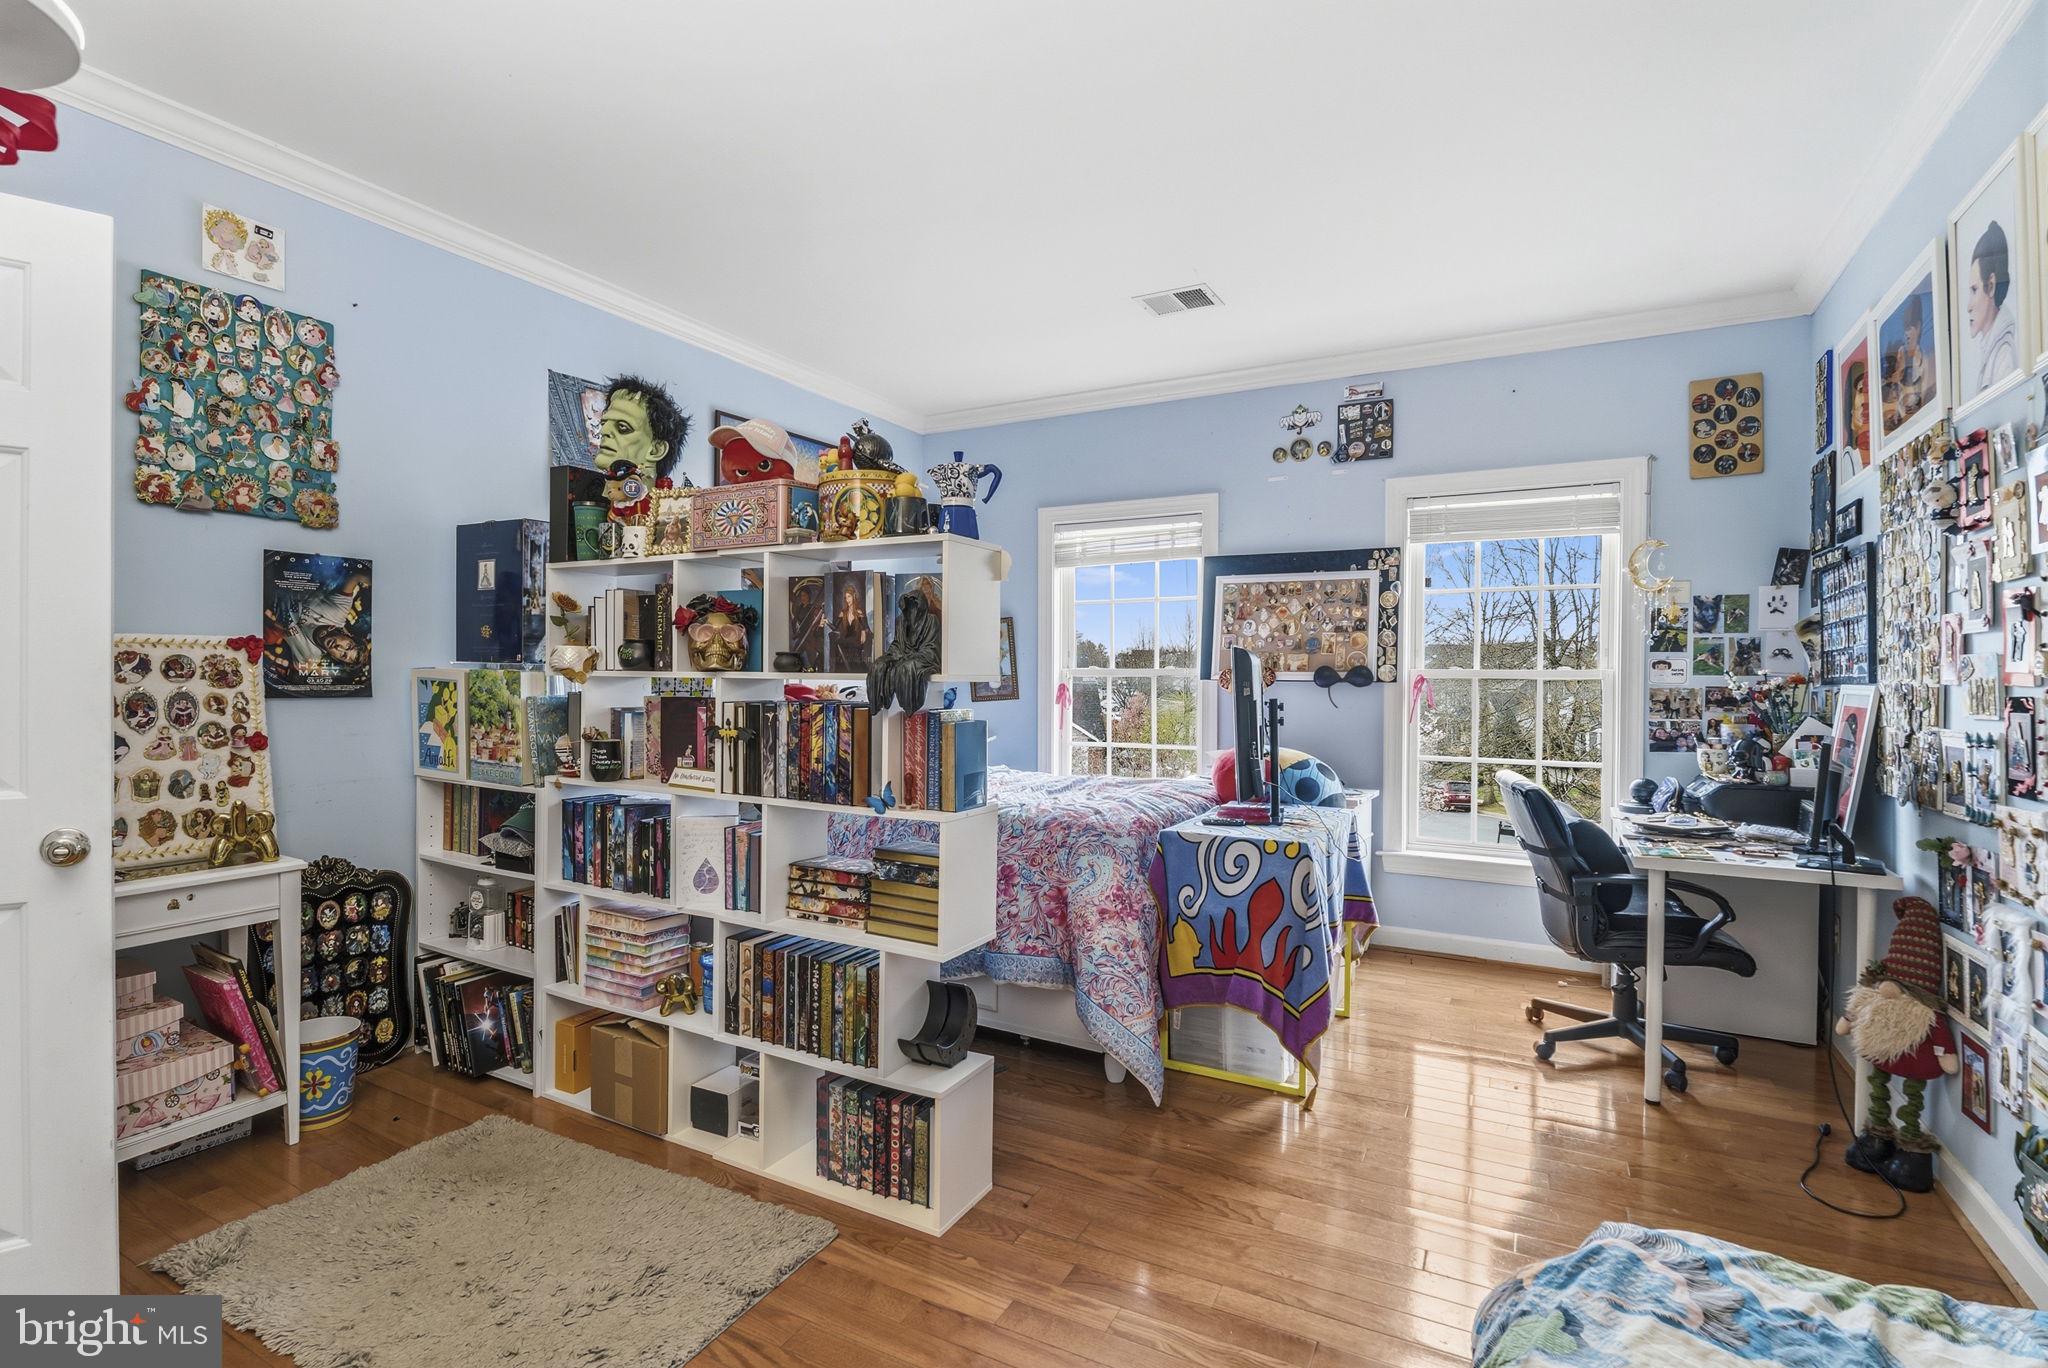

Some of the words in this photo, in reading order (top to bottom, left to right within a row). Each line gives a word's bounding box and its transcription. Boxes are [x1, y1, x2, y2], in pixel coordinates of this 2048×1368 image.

[275, 555, 363, 569] GOSLING
[298, 662, 340, 670] HAIL
[298, 669, 340, 677] MARY
[527, 711, 535, 732] VAN
[423, 747, 455, 769] Amalfi
